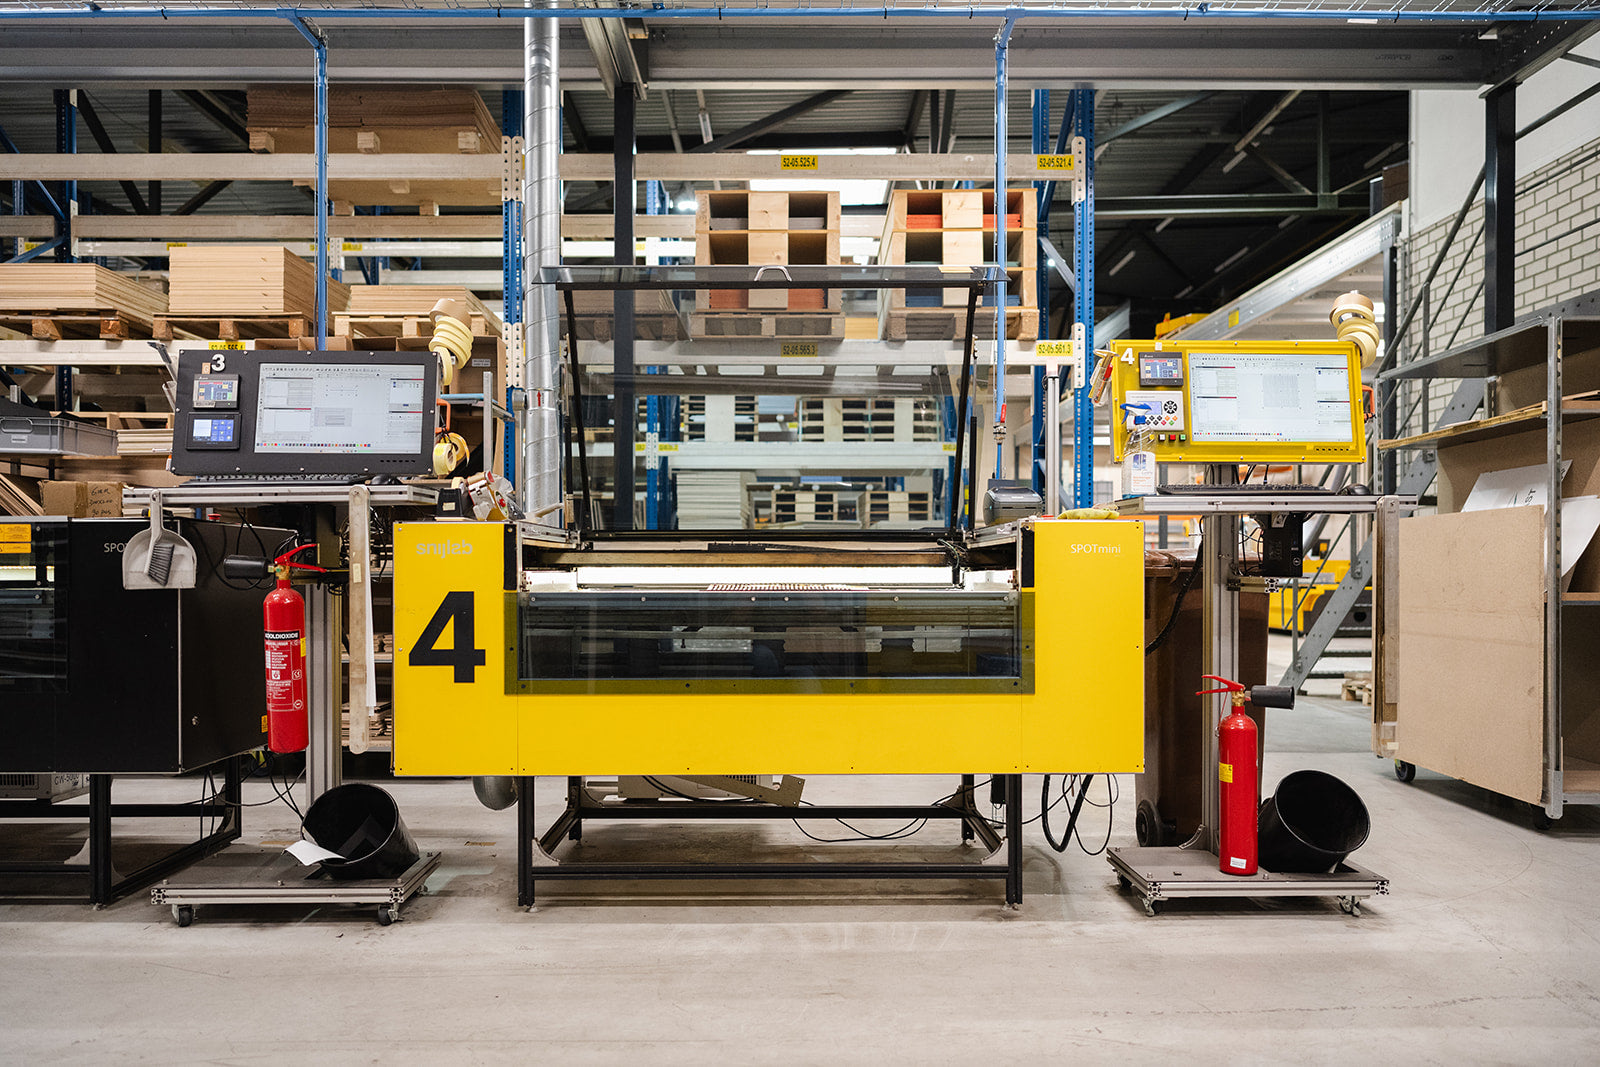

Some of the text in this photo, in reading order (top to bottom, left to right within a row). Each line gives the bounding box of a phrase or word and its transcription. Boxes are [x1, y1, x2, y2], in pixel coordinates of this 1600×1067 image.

[211, 353, 226, 372] 3
[1120, 347, 1135, 365] 4
[416, 539, 473, 559] snijlab
[1070, 543, 1121, 554] SPOTmini
[408, 590, 486, 684] 4
